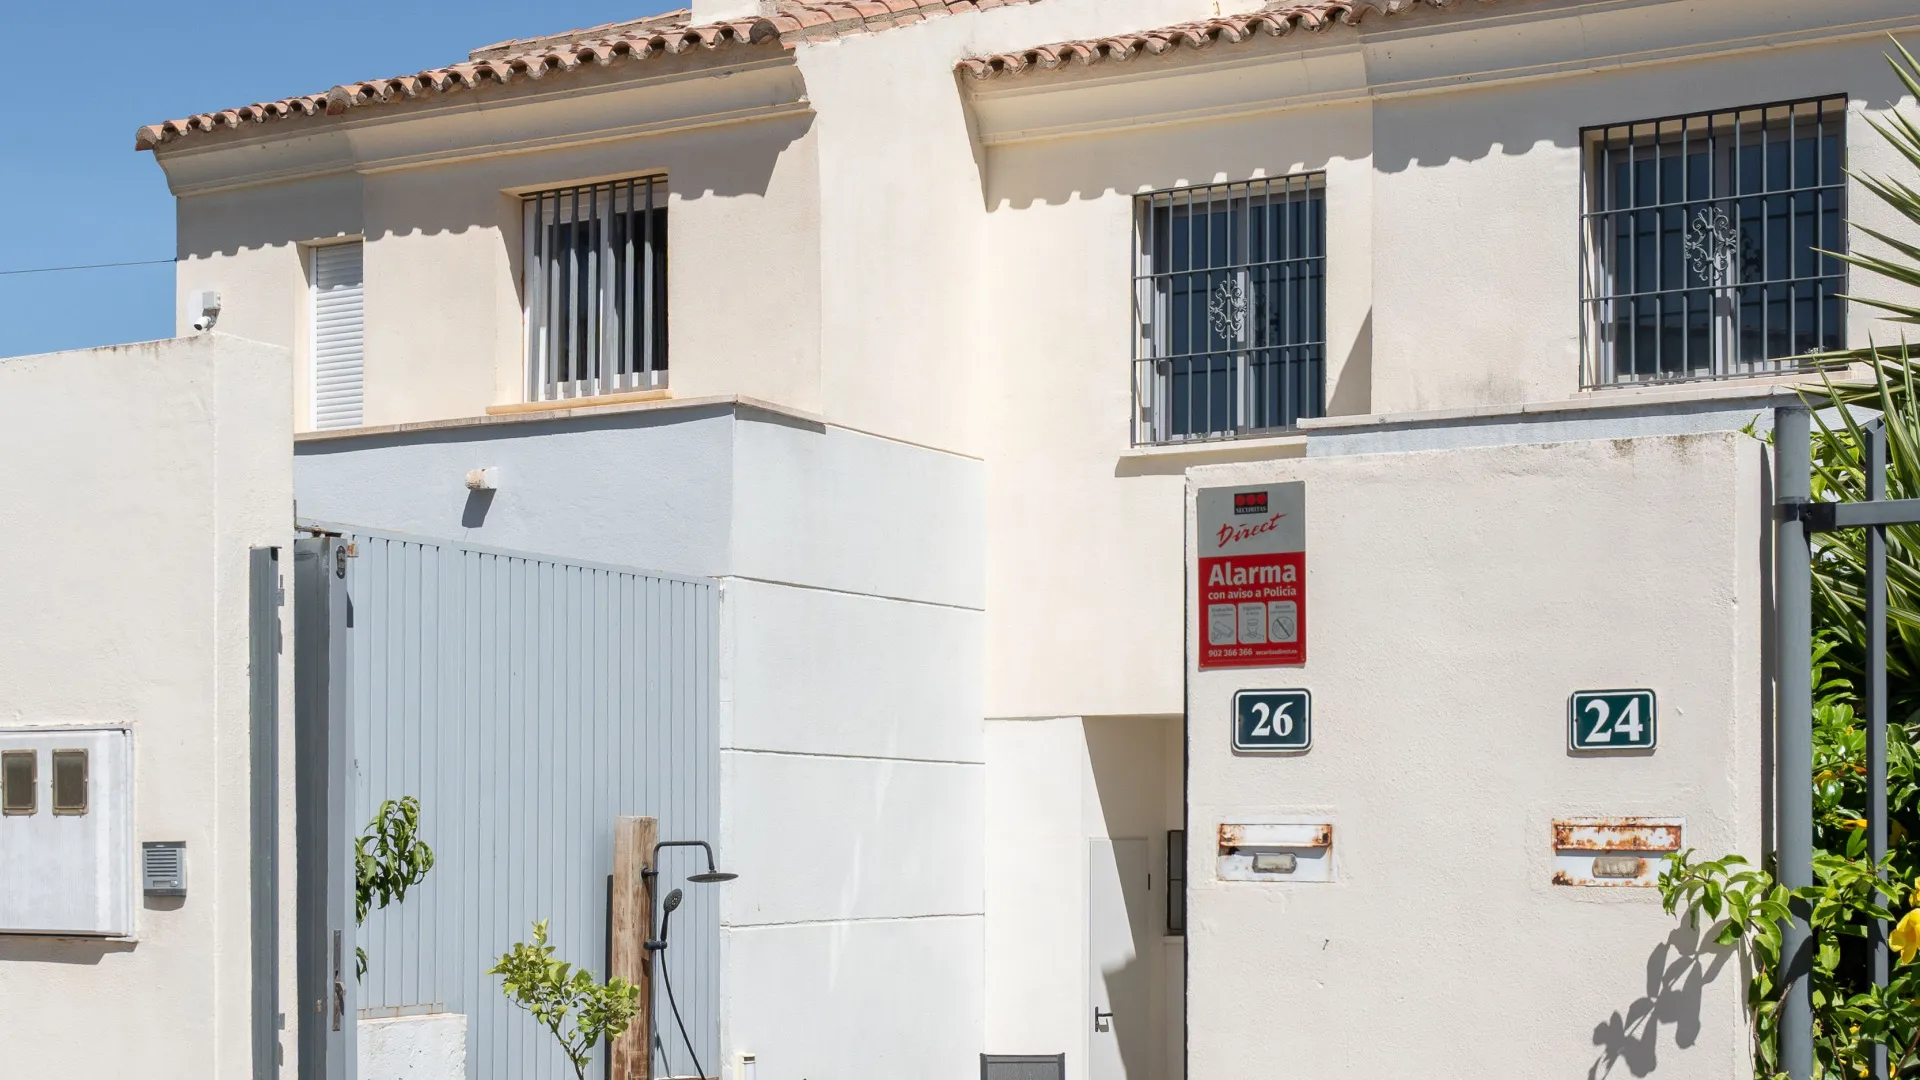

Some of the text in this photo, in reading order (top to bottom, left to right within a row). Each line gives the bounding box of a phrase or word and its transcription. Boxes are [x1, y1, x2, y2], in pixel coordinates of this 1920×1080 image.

[1216, 512, 1288, 548] Direct
[1208, 561, 1297, 587] Alarma
[1208, 586, 1297, 600] con aviso a Policía
[1208, 649, 1222, 657] 902
[1251, 702, 1294, 737] 26
[1584, 697, 1644, 743] 24
